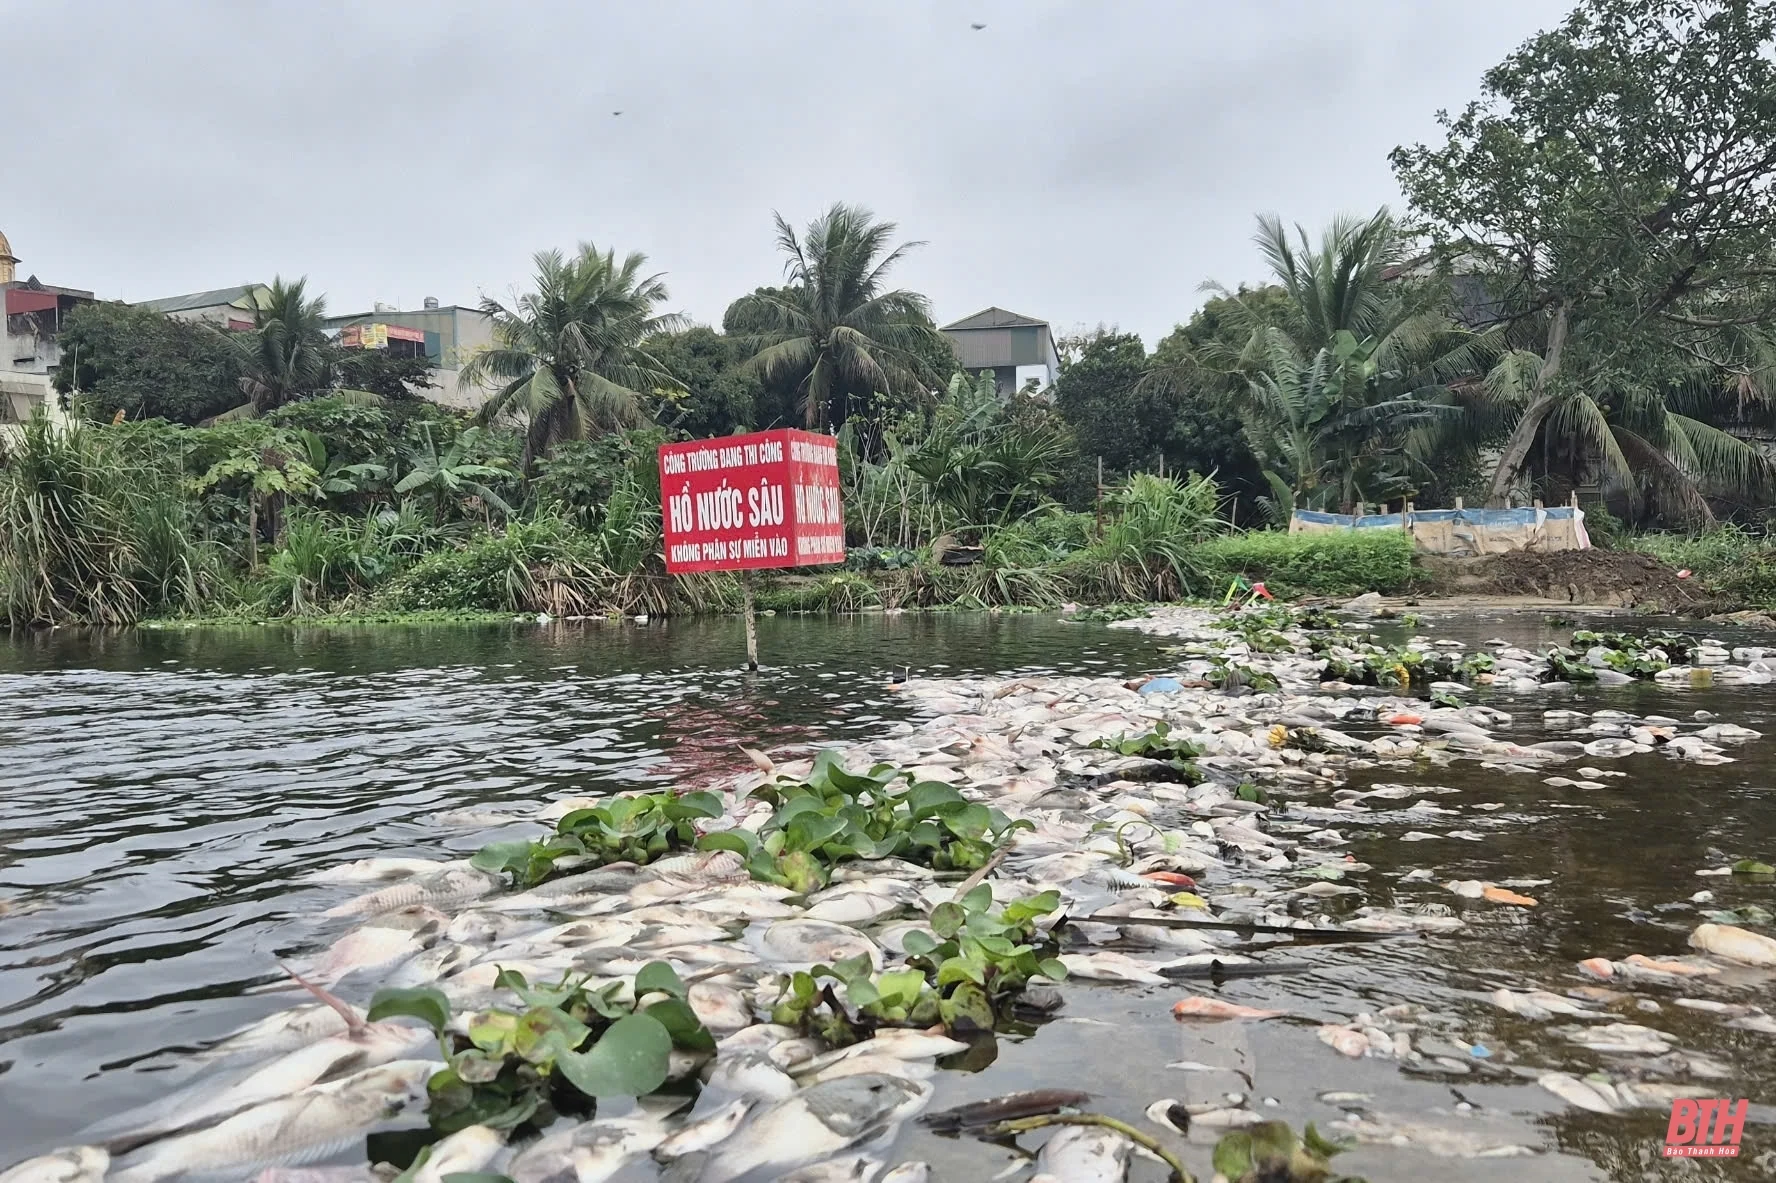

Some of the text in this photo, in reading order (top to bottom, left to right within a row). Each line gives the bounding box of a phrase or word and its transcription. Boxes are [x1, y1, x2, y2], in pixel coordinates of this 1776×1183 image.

[663, 451, 686, 475] CÔNG
[686, 445, 719, 472] TRƯỜNG
[719, 446, 743, 469] ĐANG
[743, 444, 758, 466] THI
[759, 438, 783, 464] CÔNG
[669, 477, 784, 533] HỒ NƯỚC SÂU
[671, 540, 701, 563] KHÔNG
[702, 538, 727, 565] PHẬN
[729, 538, 742, 563] SỰ
[769, 533, 788, 557] VÀO
